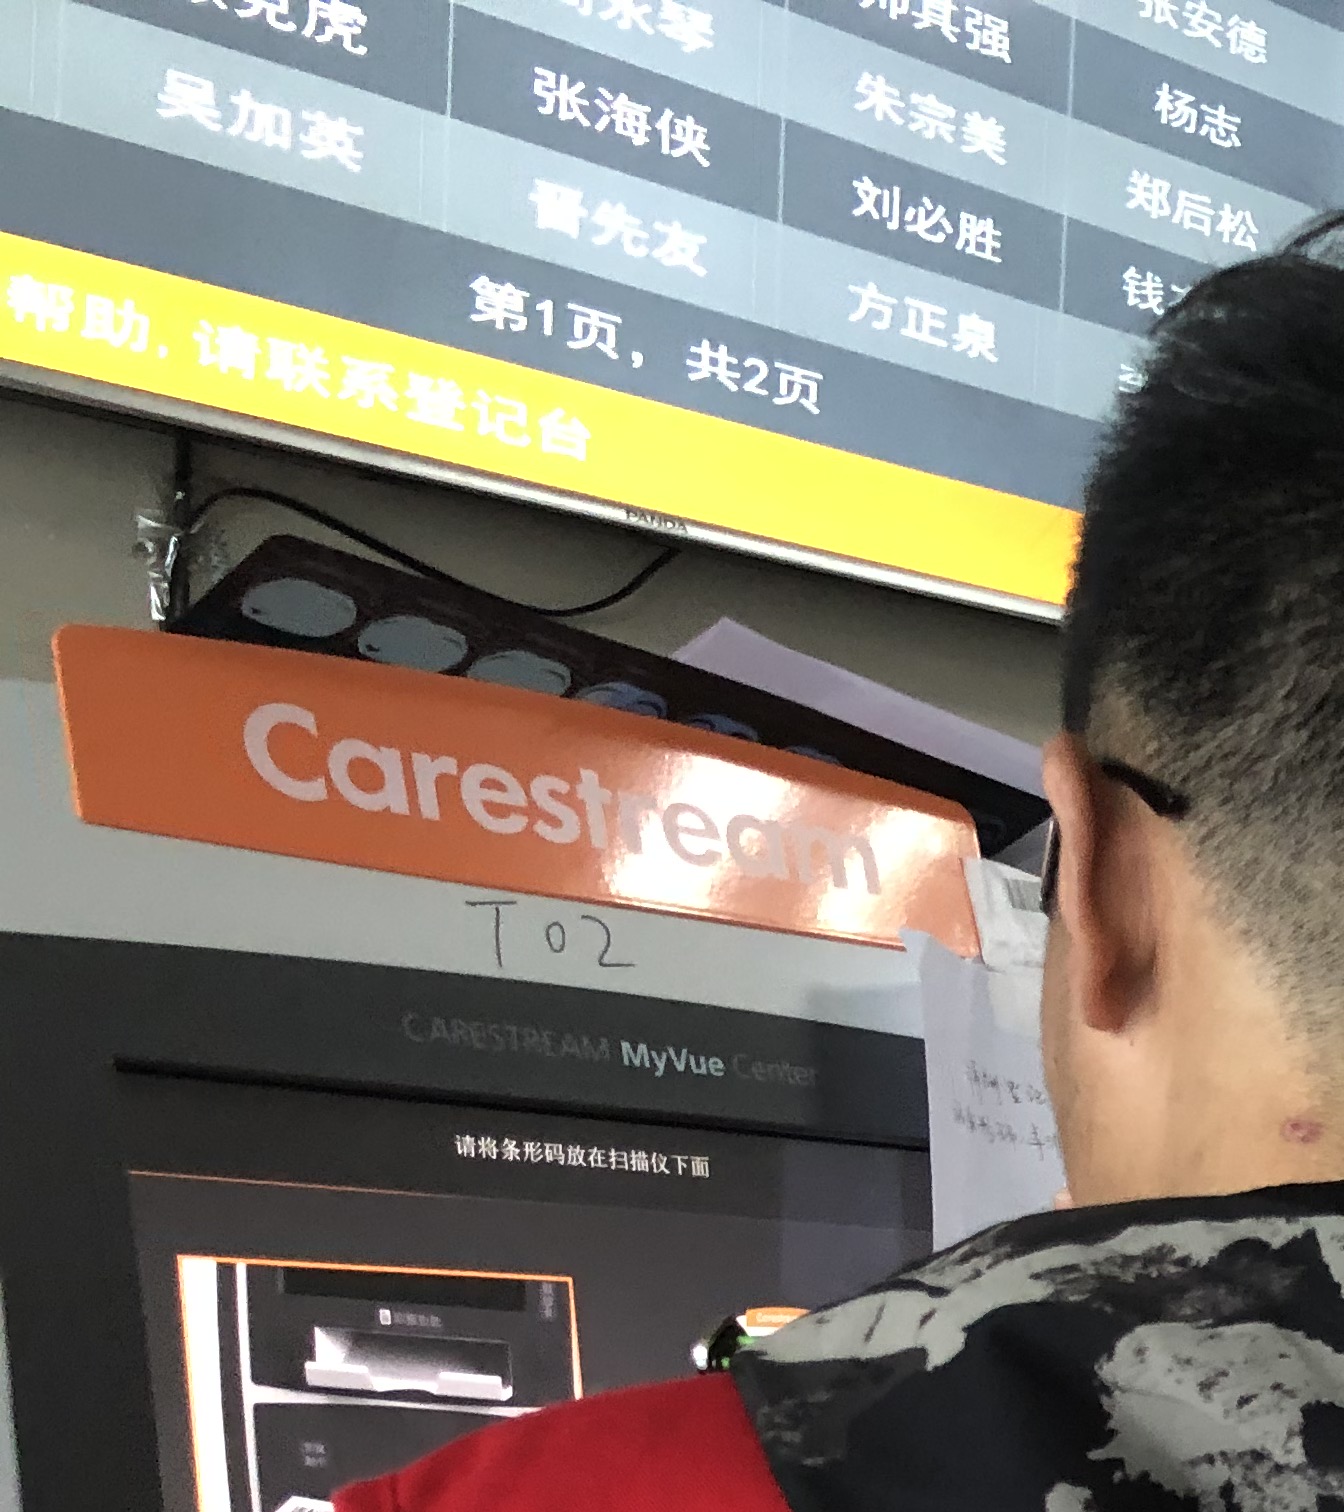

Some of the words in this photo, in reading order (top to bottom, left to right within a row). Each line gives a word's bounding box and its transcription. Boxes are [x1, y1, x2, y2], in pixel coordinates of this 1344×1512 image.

[1136, 0, 1268, 64] 张安德
[156, 68, 365, 173] 吴加英
[532, 66, 712, 168] 张海侠
[854, 70, 1008, 166] 朱宗美
[1154, 82, 1242, 150] 杨志
[851, 175, 1003, 263] 刘必胜
[1125, 169, 1259, 253] 郑后松
[848, 281, 1000, 363] 方正泉
[241, 701, 882, 896] Carestream
[402, 1011, 610, 1062] CARESTREAM
[620, 1039, 726, 1079] MyVue
[733, 1053, 817, 1087] Center
[454, 1133, 711, 1179] 请将条形码放在扫描仪下面
